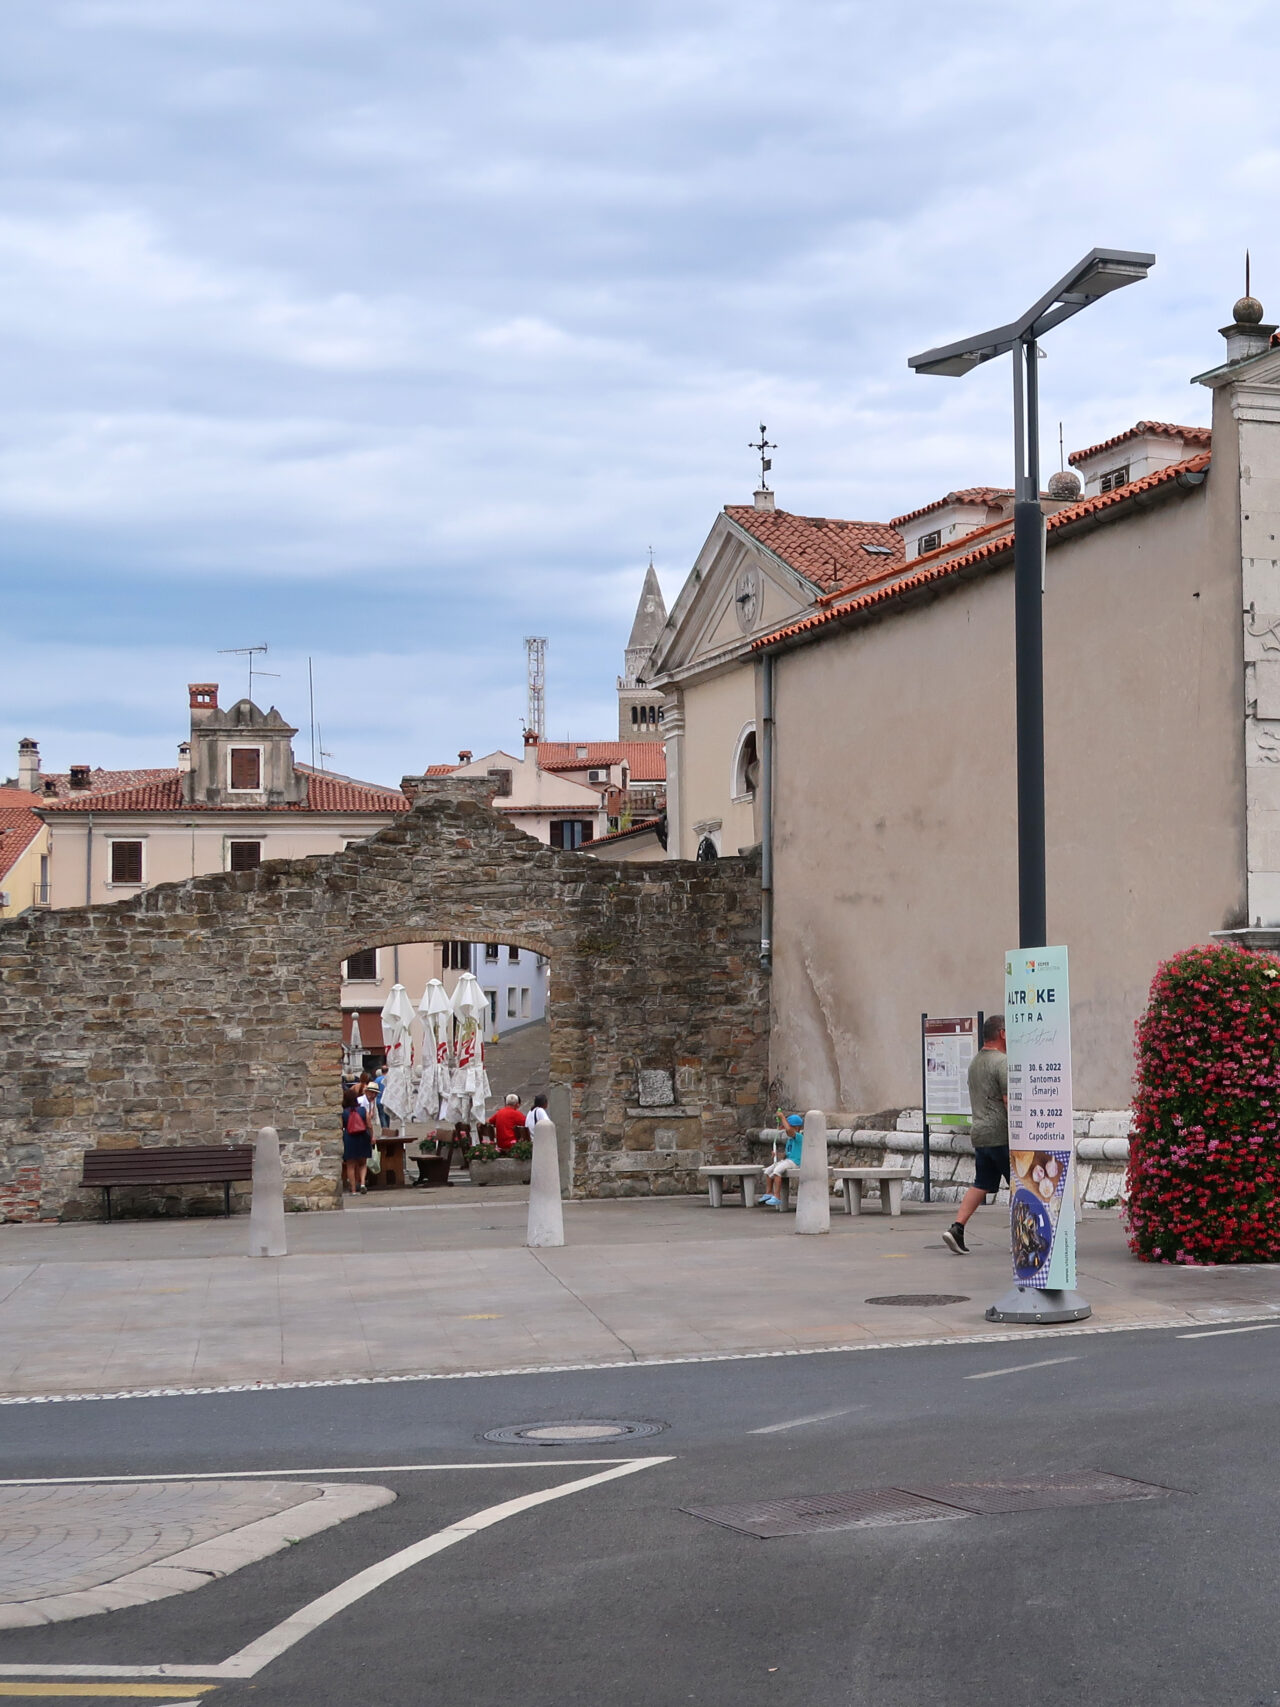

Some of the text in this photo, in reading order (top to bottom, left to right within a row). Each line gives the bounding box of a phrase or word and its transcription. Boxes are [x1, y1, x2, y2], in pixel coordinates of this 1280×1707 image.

[1012, 1012, 1043, 1023] ISTRA
[1046, 1063, 1061, 1071] 2022
[1030, 1075, 1061, 1083] Santomas
[1047, 1108, 1062, 1116] 2022
[1036, 1121, 1055, 1130] Koper
[1029, 1132, 1065, 1141] Capodistria
